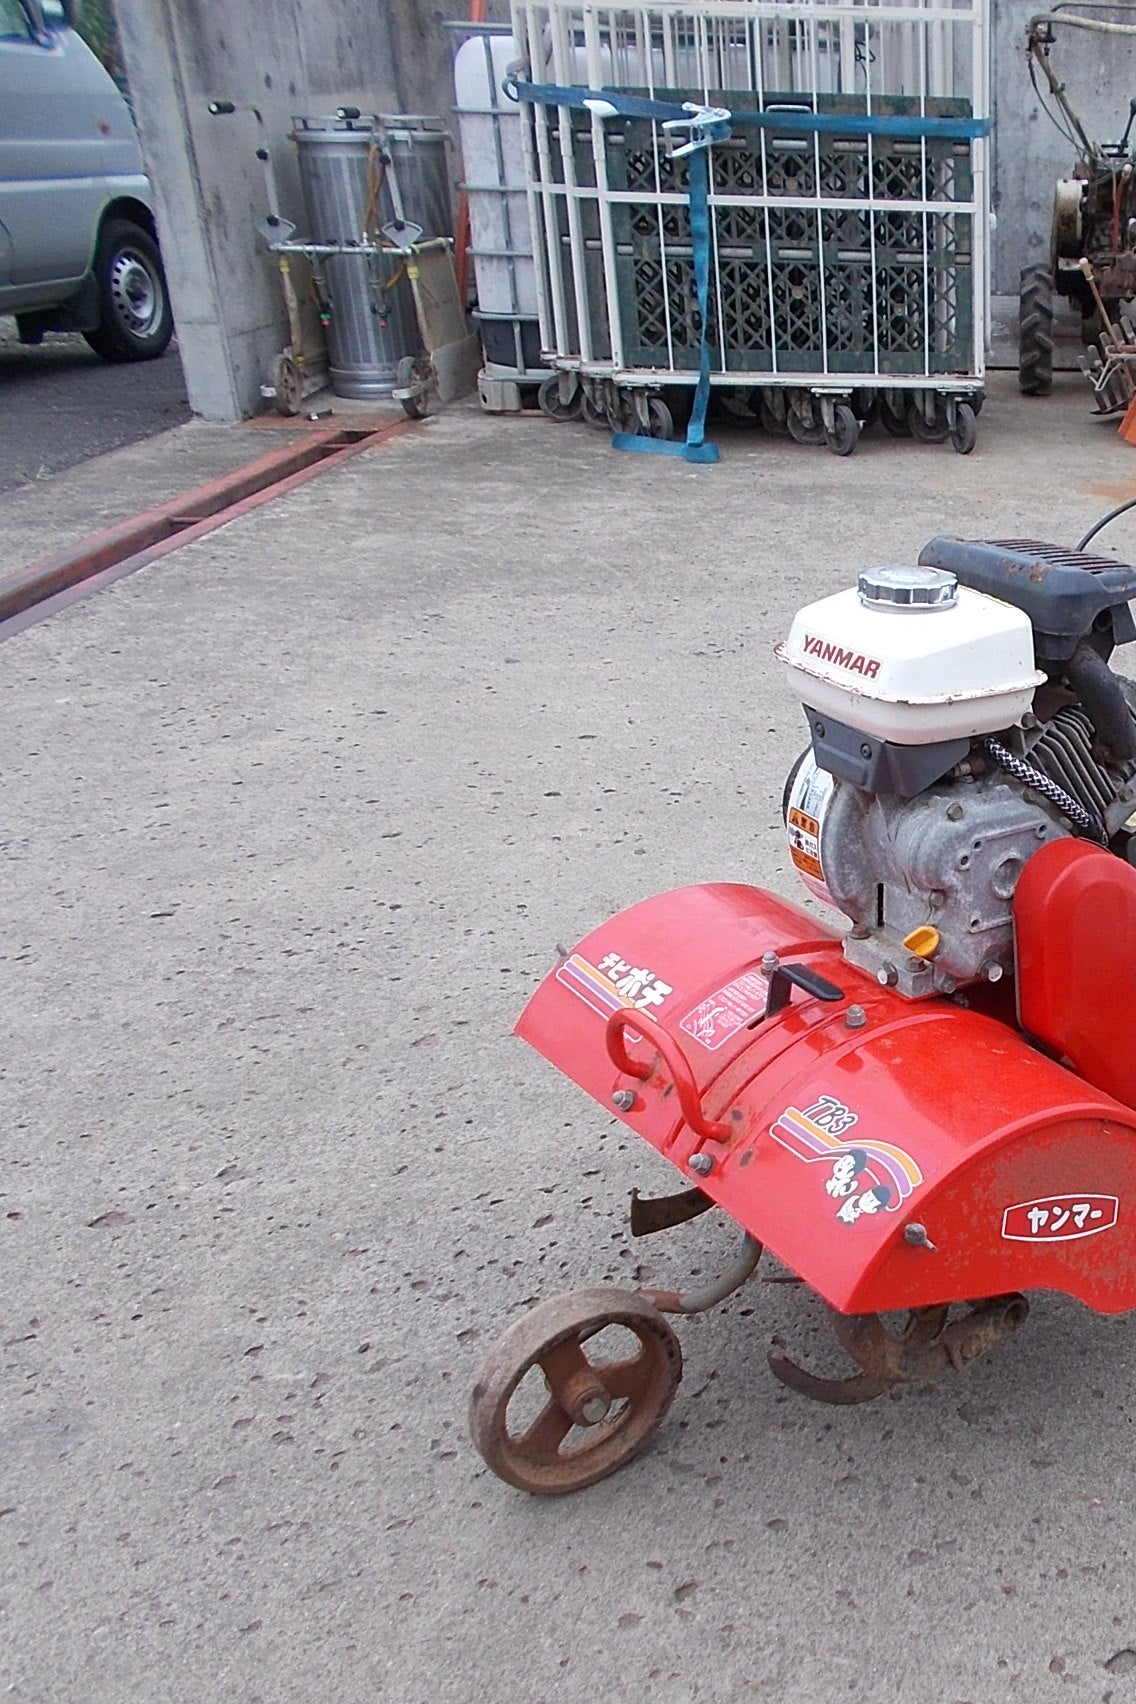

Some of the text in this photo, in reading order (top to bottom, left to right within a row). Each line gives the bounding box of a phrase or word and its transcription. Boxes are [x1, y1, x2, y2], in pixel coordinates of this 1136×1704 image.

[803, 634, 881, 679] YANMAR
[801, 1096, 858, 1136] TB3
[1027, 1203, 1102, 1234] ヤンマー
